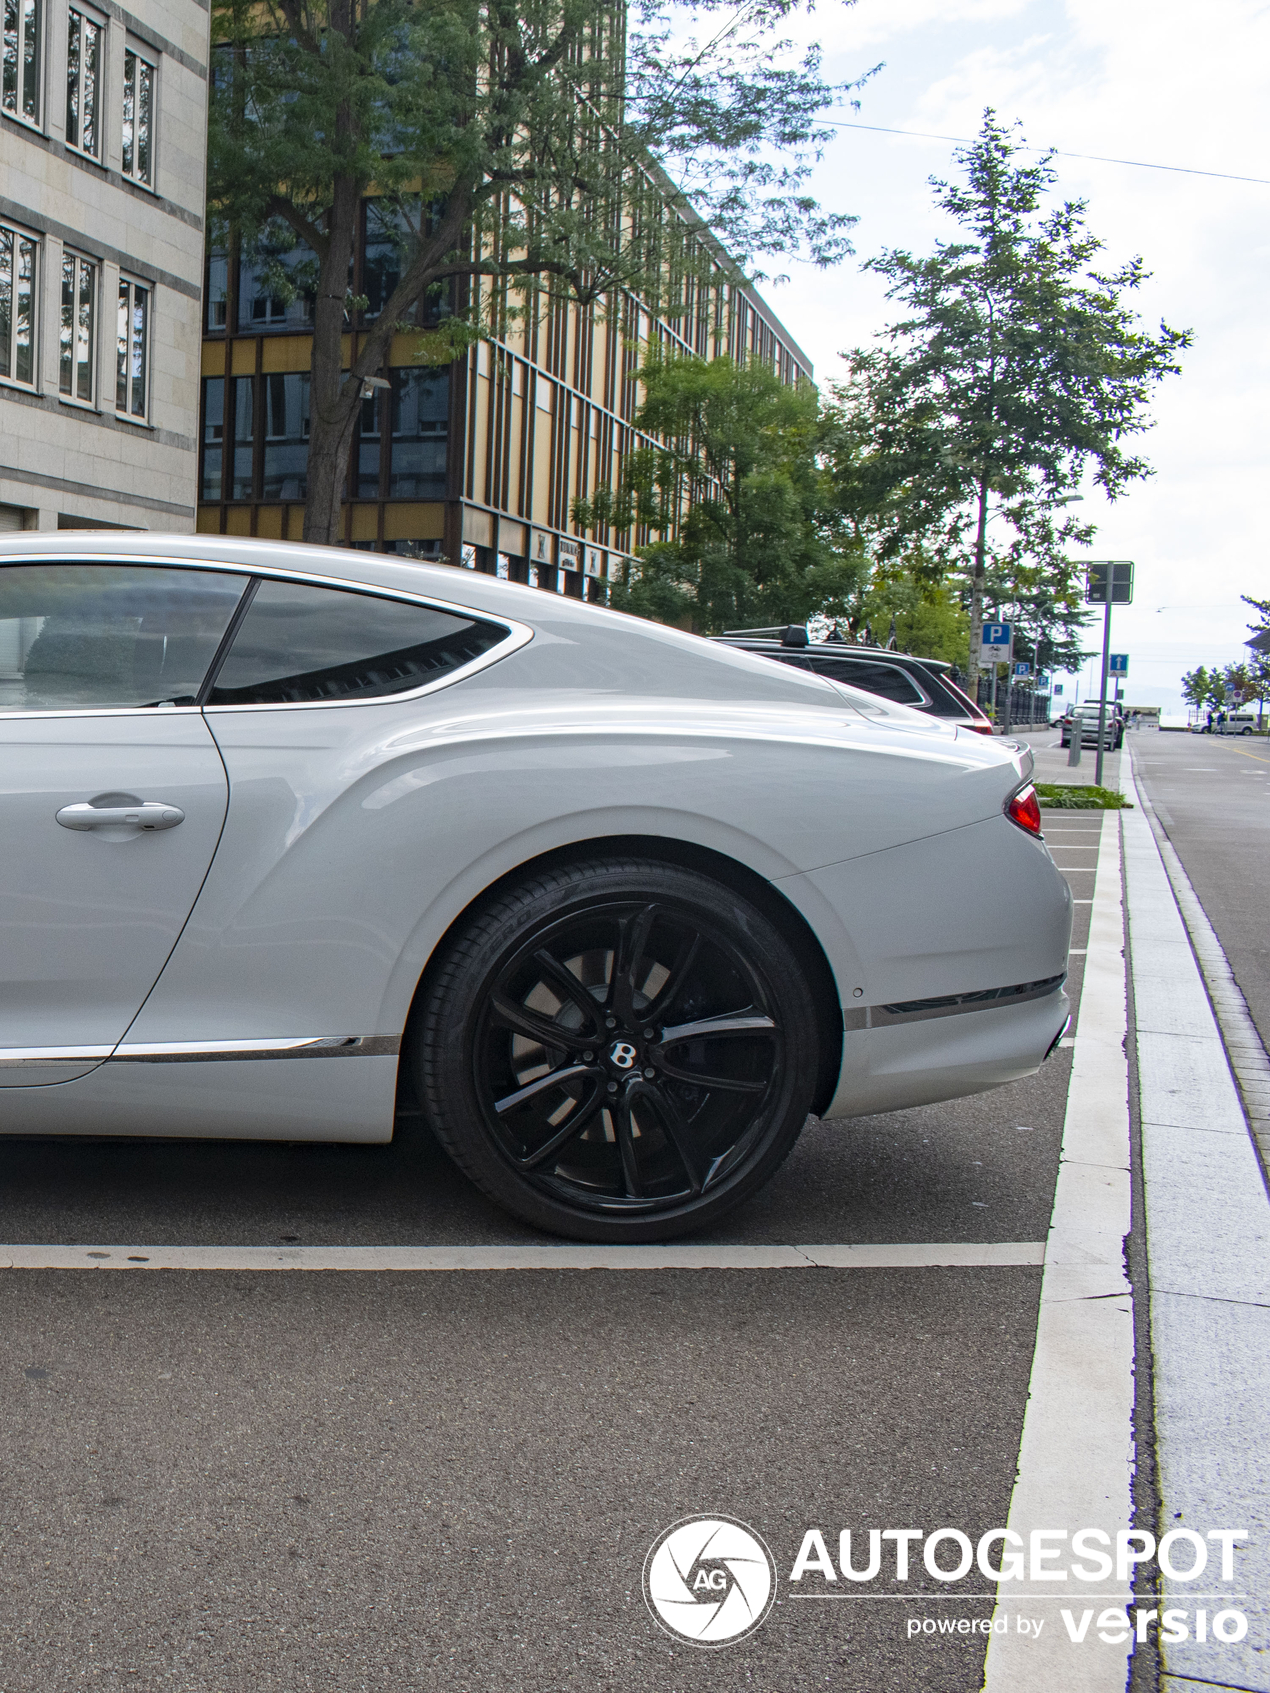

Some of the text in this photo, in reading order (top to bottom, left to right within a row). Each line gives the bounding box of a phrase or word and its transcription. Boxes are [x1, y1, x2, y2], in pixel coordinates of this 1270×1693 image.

[990, 626, 1002, 642] P
[1019, 665, 1025, 674] P
[610, 1042, 637, 1068] B
